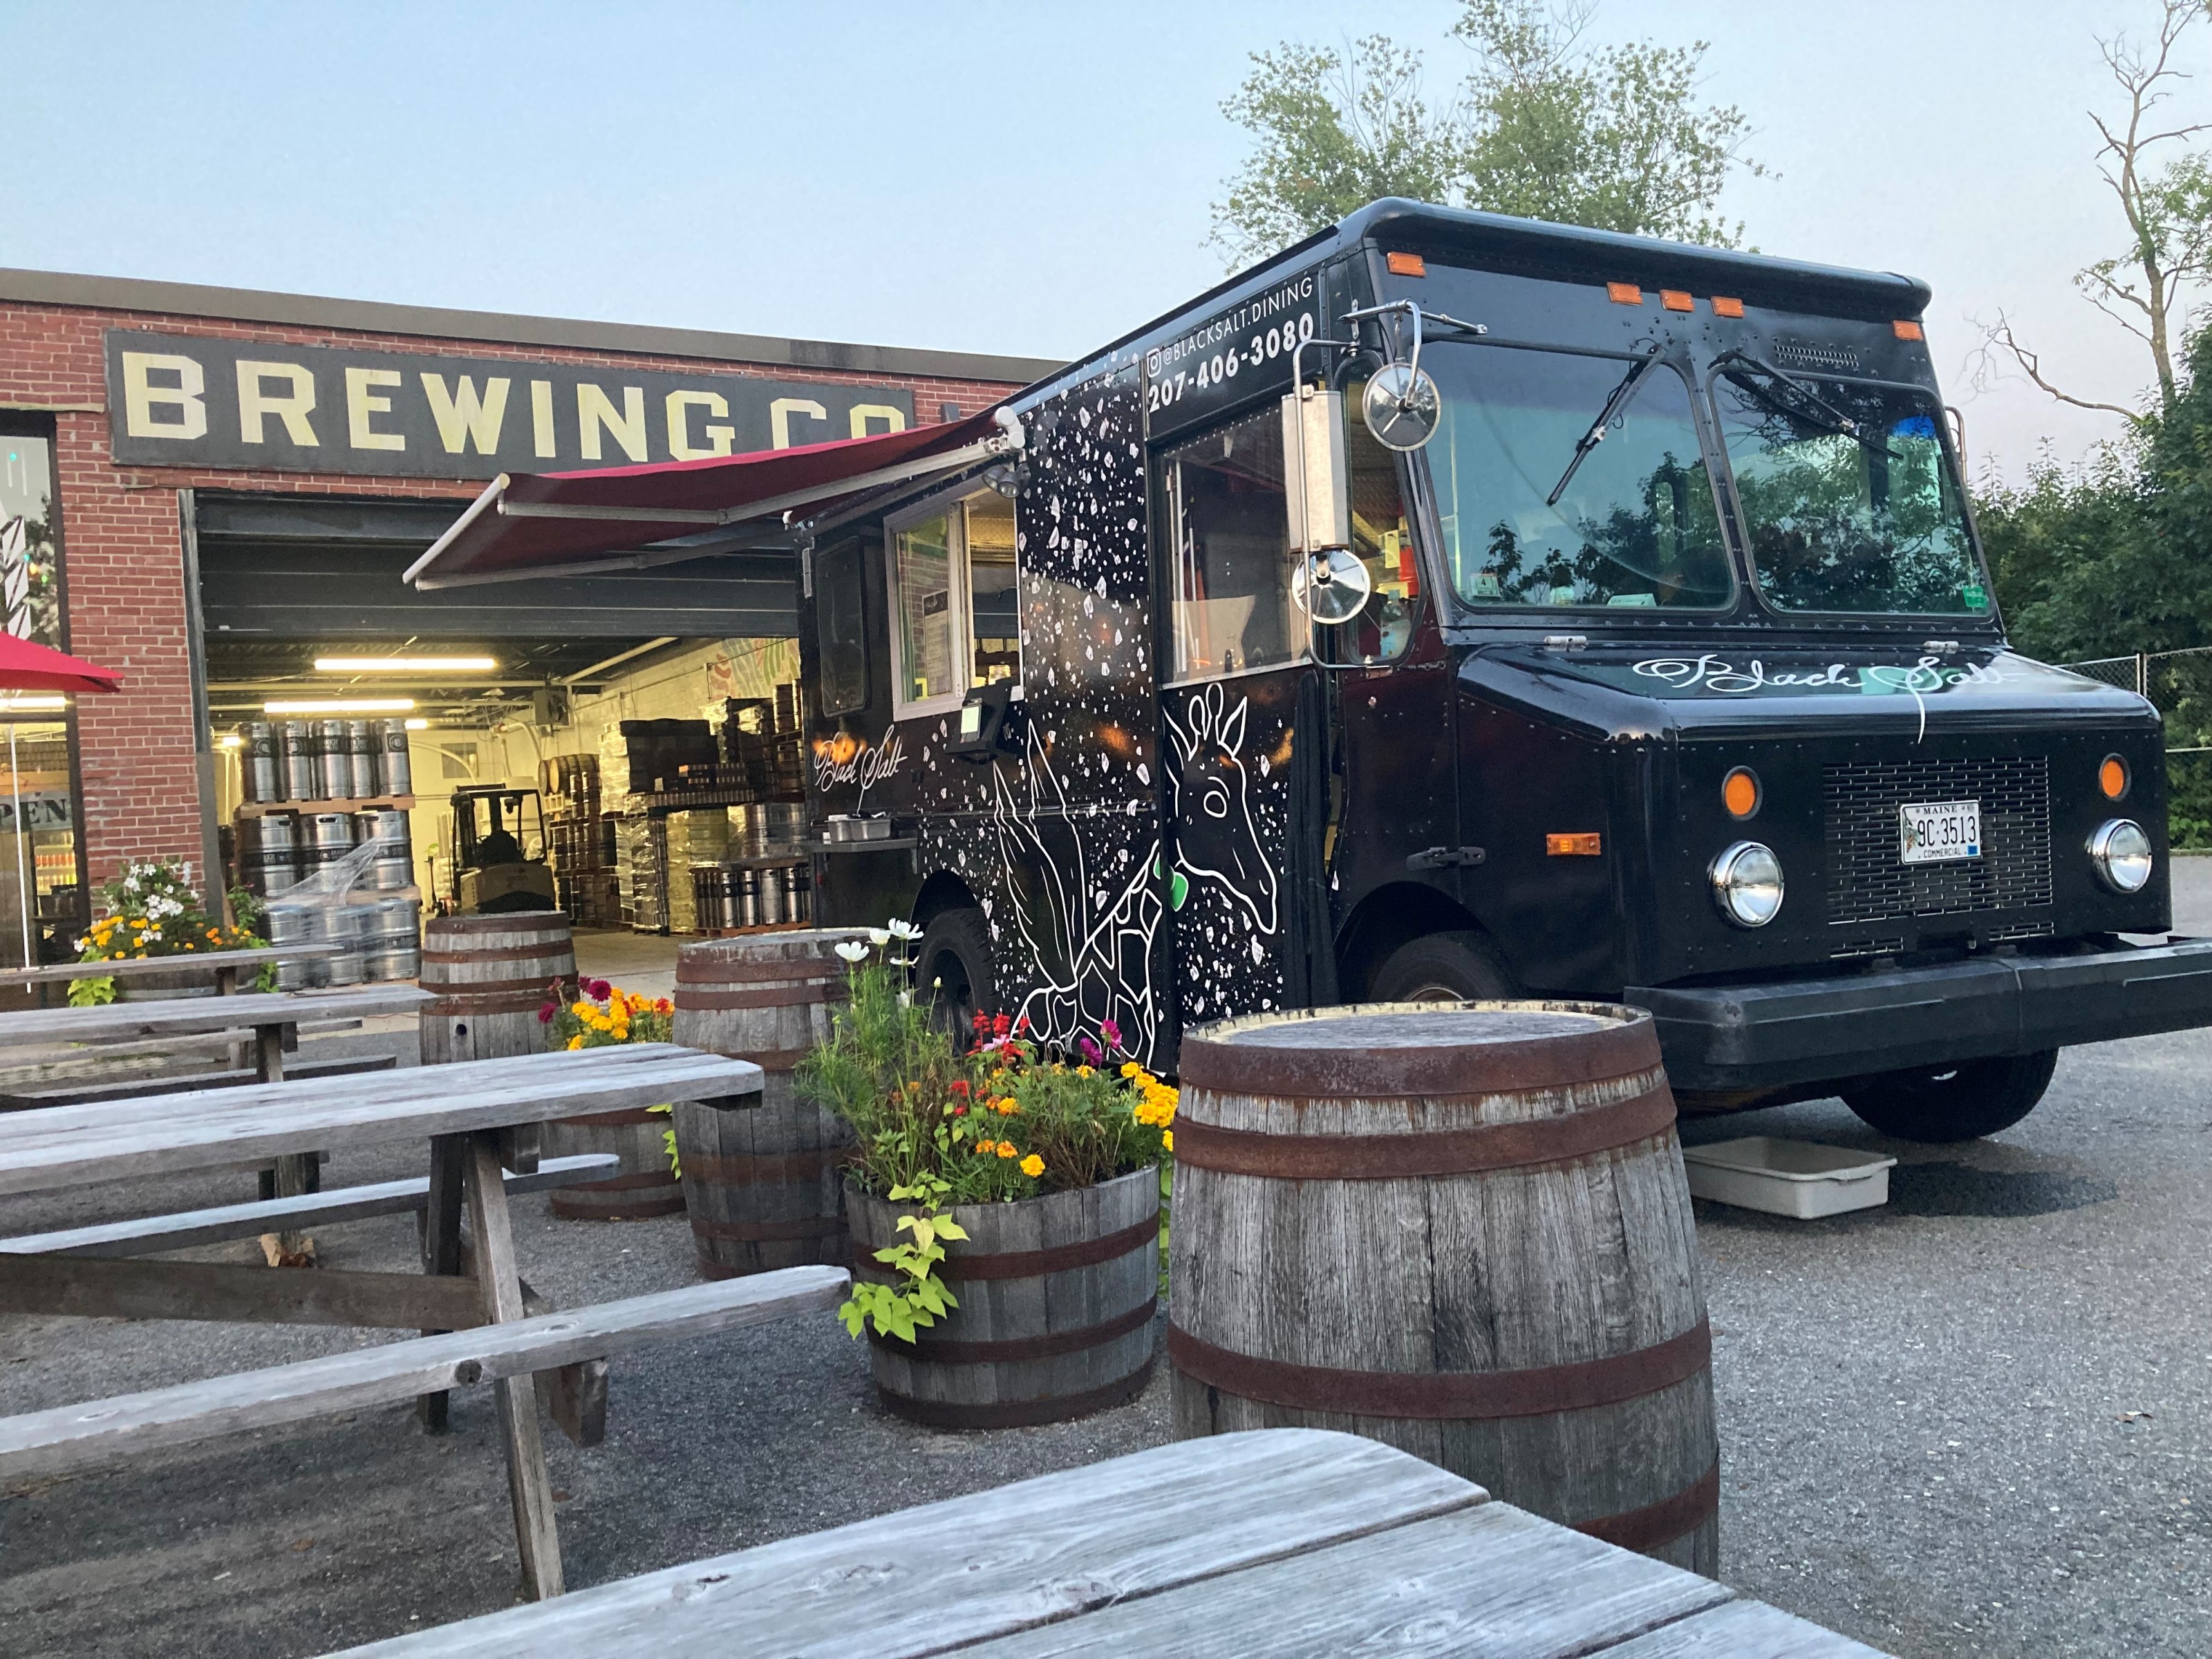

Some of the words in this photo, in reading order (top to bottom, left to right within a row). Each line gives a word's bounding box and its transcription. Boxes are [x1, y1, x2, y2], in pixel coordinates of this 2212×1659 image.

[1148, 312, 1313, 413] 207-406-3080
[1163, 276, 1313, 366] @BLACKSALT.DINING
[122, 351, 735, 462] BREWING
[1632, 654, 1868, 692] Black
[1868, 657, 2031, 744] Salt
[814, 731, 862, 791] Black
[856, 724, 908, 814] Salt
[1923, 805, 1958, 814] MAINE
[1924, 847, 1962, 859] COMMERCIAL
